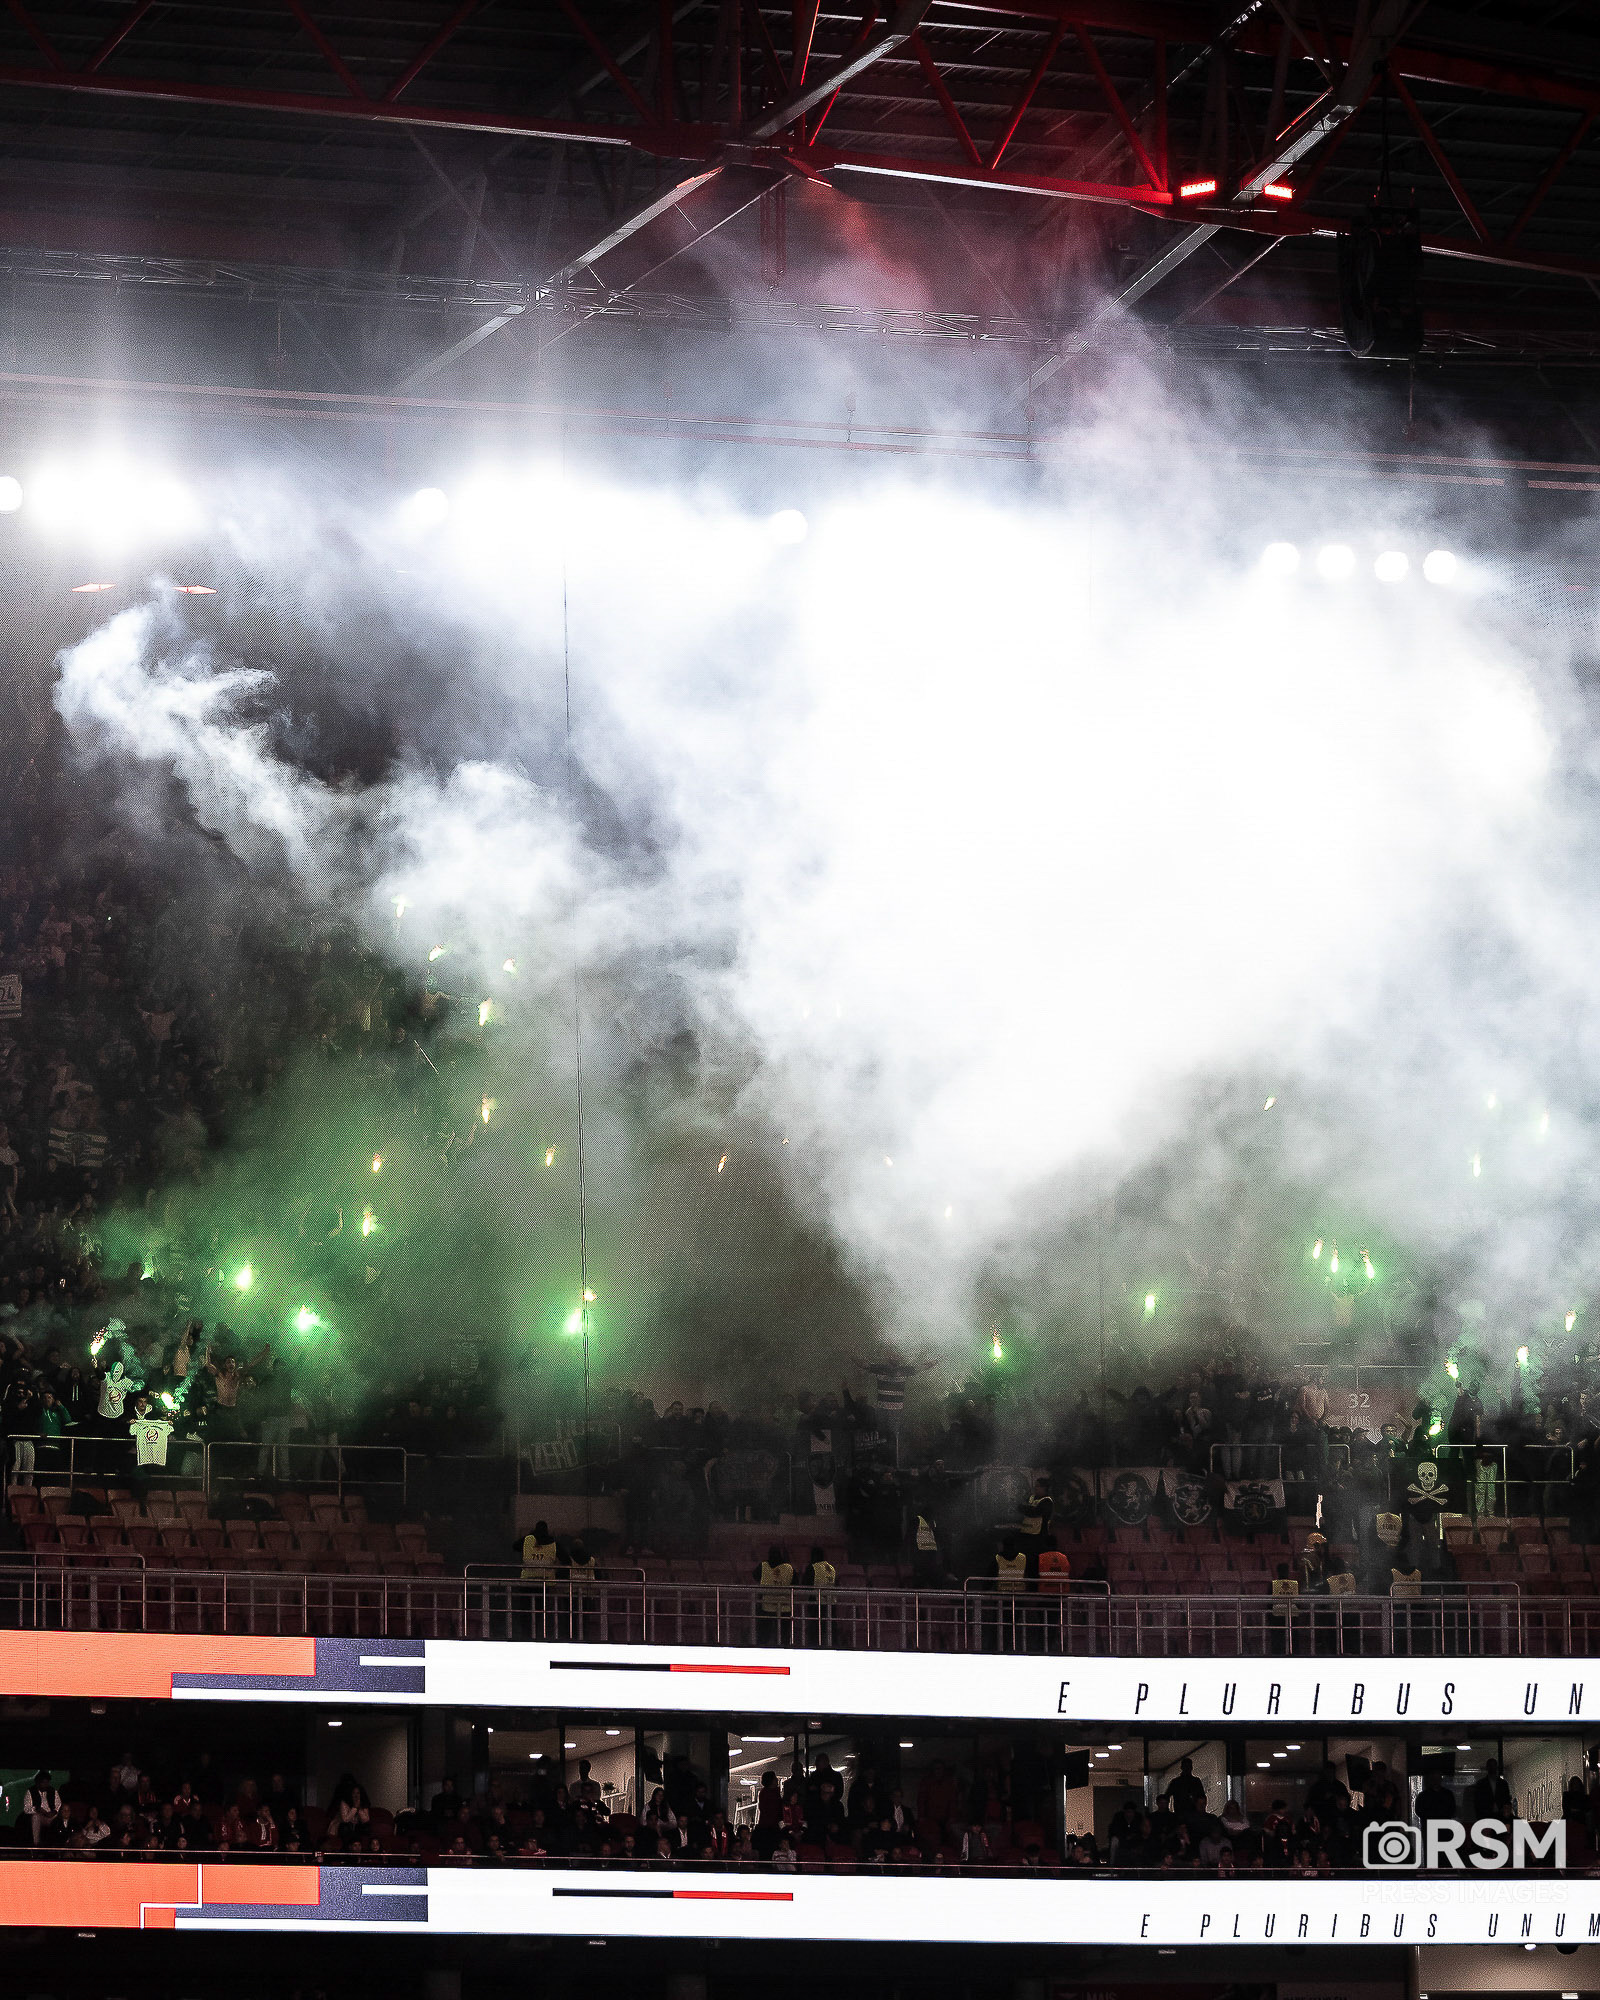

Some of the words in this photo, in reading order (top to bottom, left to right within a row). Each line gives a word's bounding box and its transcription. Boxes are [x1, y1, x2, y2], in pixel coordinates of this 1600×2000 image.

[1348, 1393, 1370, 1409] 32
[1057, 1681, 1072, 1715] E
[1135, 1682, 1456, 1716] PLURIBUS
[1140, 1913, 1151, 1938] E
[1200, 1913, 1438, 1938] PLURIBUS
[1488, 1913, 1600, 1938] UNUM
